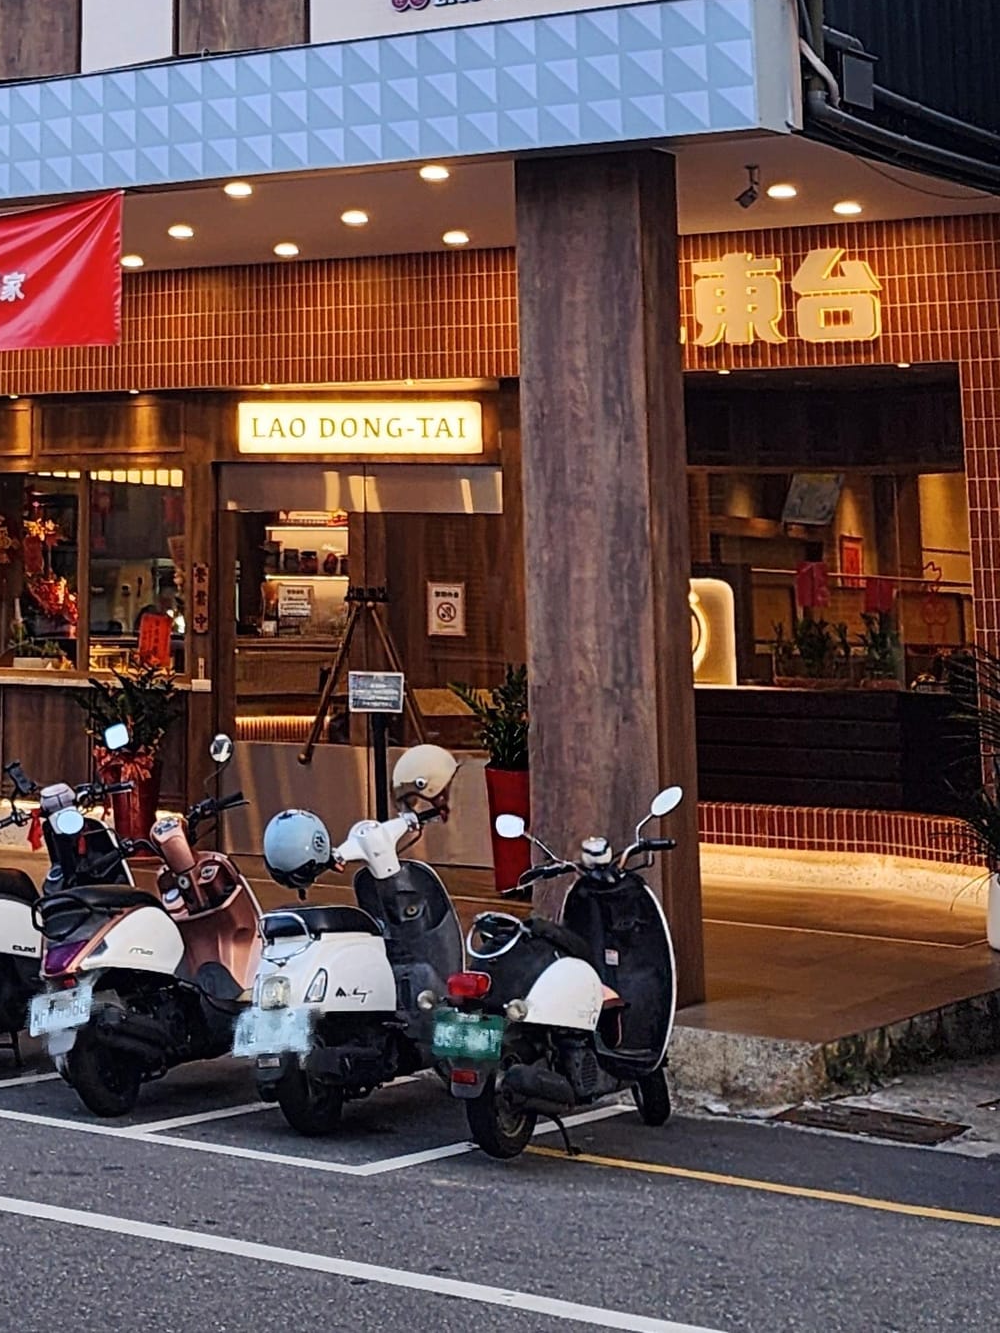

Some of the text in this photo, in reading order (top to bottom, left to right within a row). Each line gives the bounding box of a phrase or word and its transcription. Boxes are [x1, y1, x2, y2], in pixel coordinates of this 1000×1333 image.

[680, 248, 883, 347] 東台
[252, 417, 467, 438] LAO DONG-TAI
